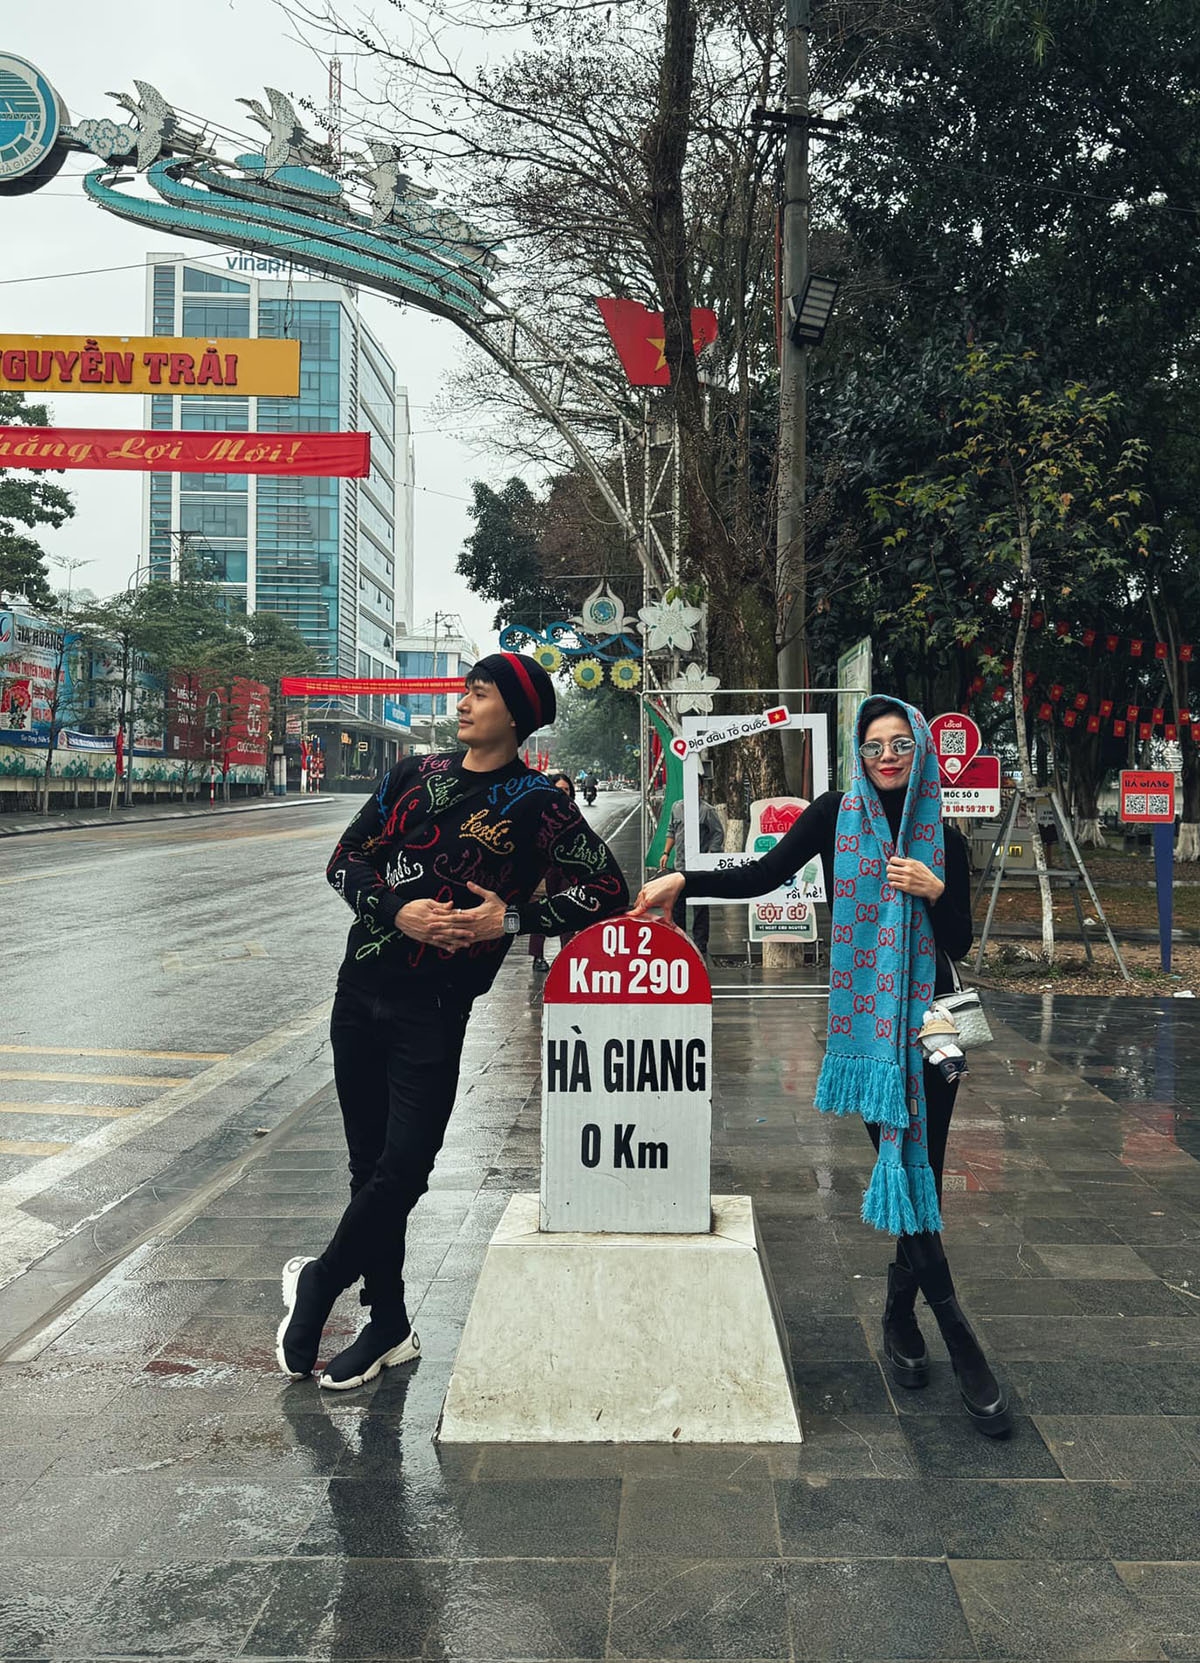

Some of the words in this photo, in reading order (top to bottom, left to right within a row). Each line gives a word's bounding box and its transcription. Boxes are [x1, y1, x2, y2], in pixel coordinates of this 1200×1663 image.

[0, 338, 134, 383] GUYỄN
[144, 347, 238, 386] TRÃI
[106, 437, 182, 464] Lợi
[196, 438, 302, 464] Mới!
[602, 925, 630, 955] QL
[637, 927, 652, 955] 2
[569, 958, 621, 993] Km
[628, 958, 690, 994] 290
[548, 1025, 592, 1092] HÀ
[603, 1039, 706, 1093] GIANG
[581, 1124, 601, 1168] 0
[614, 1124, 668, 1169] Km
